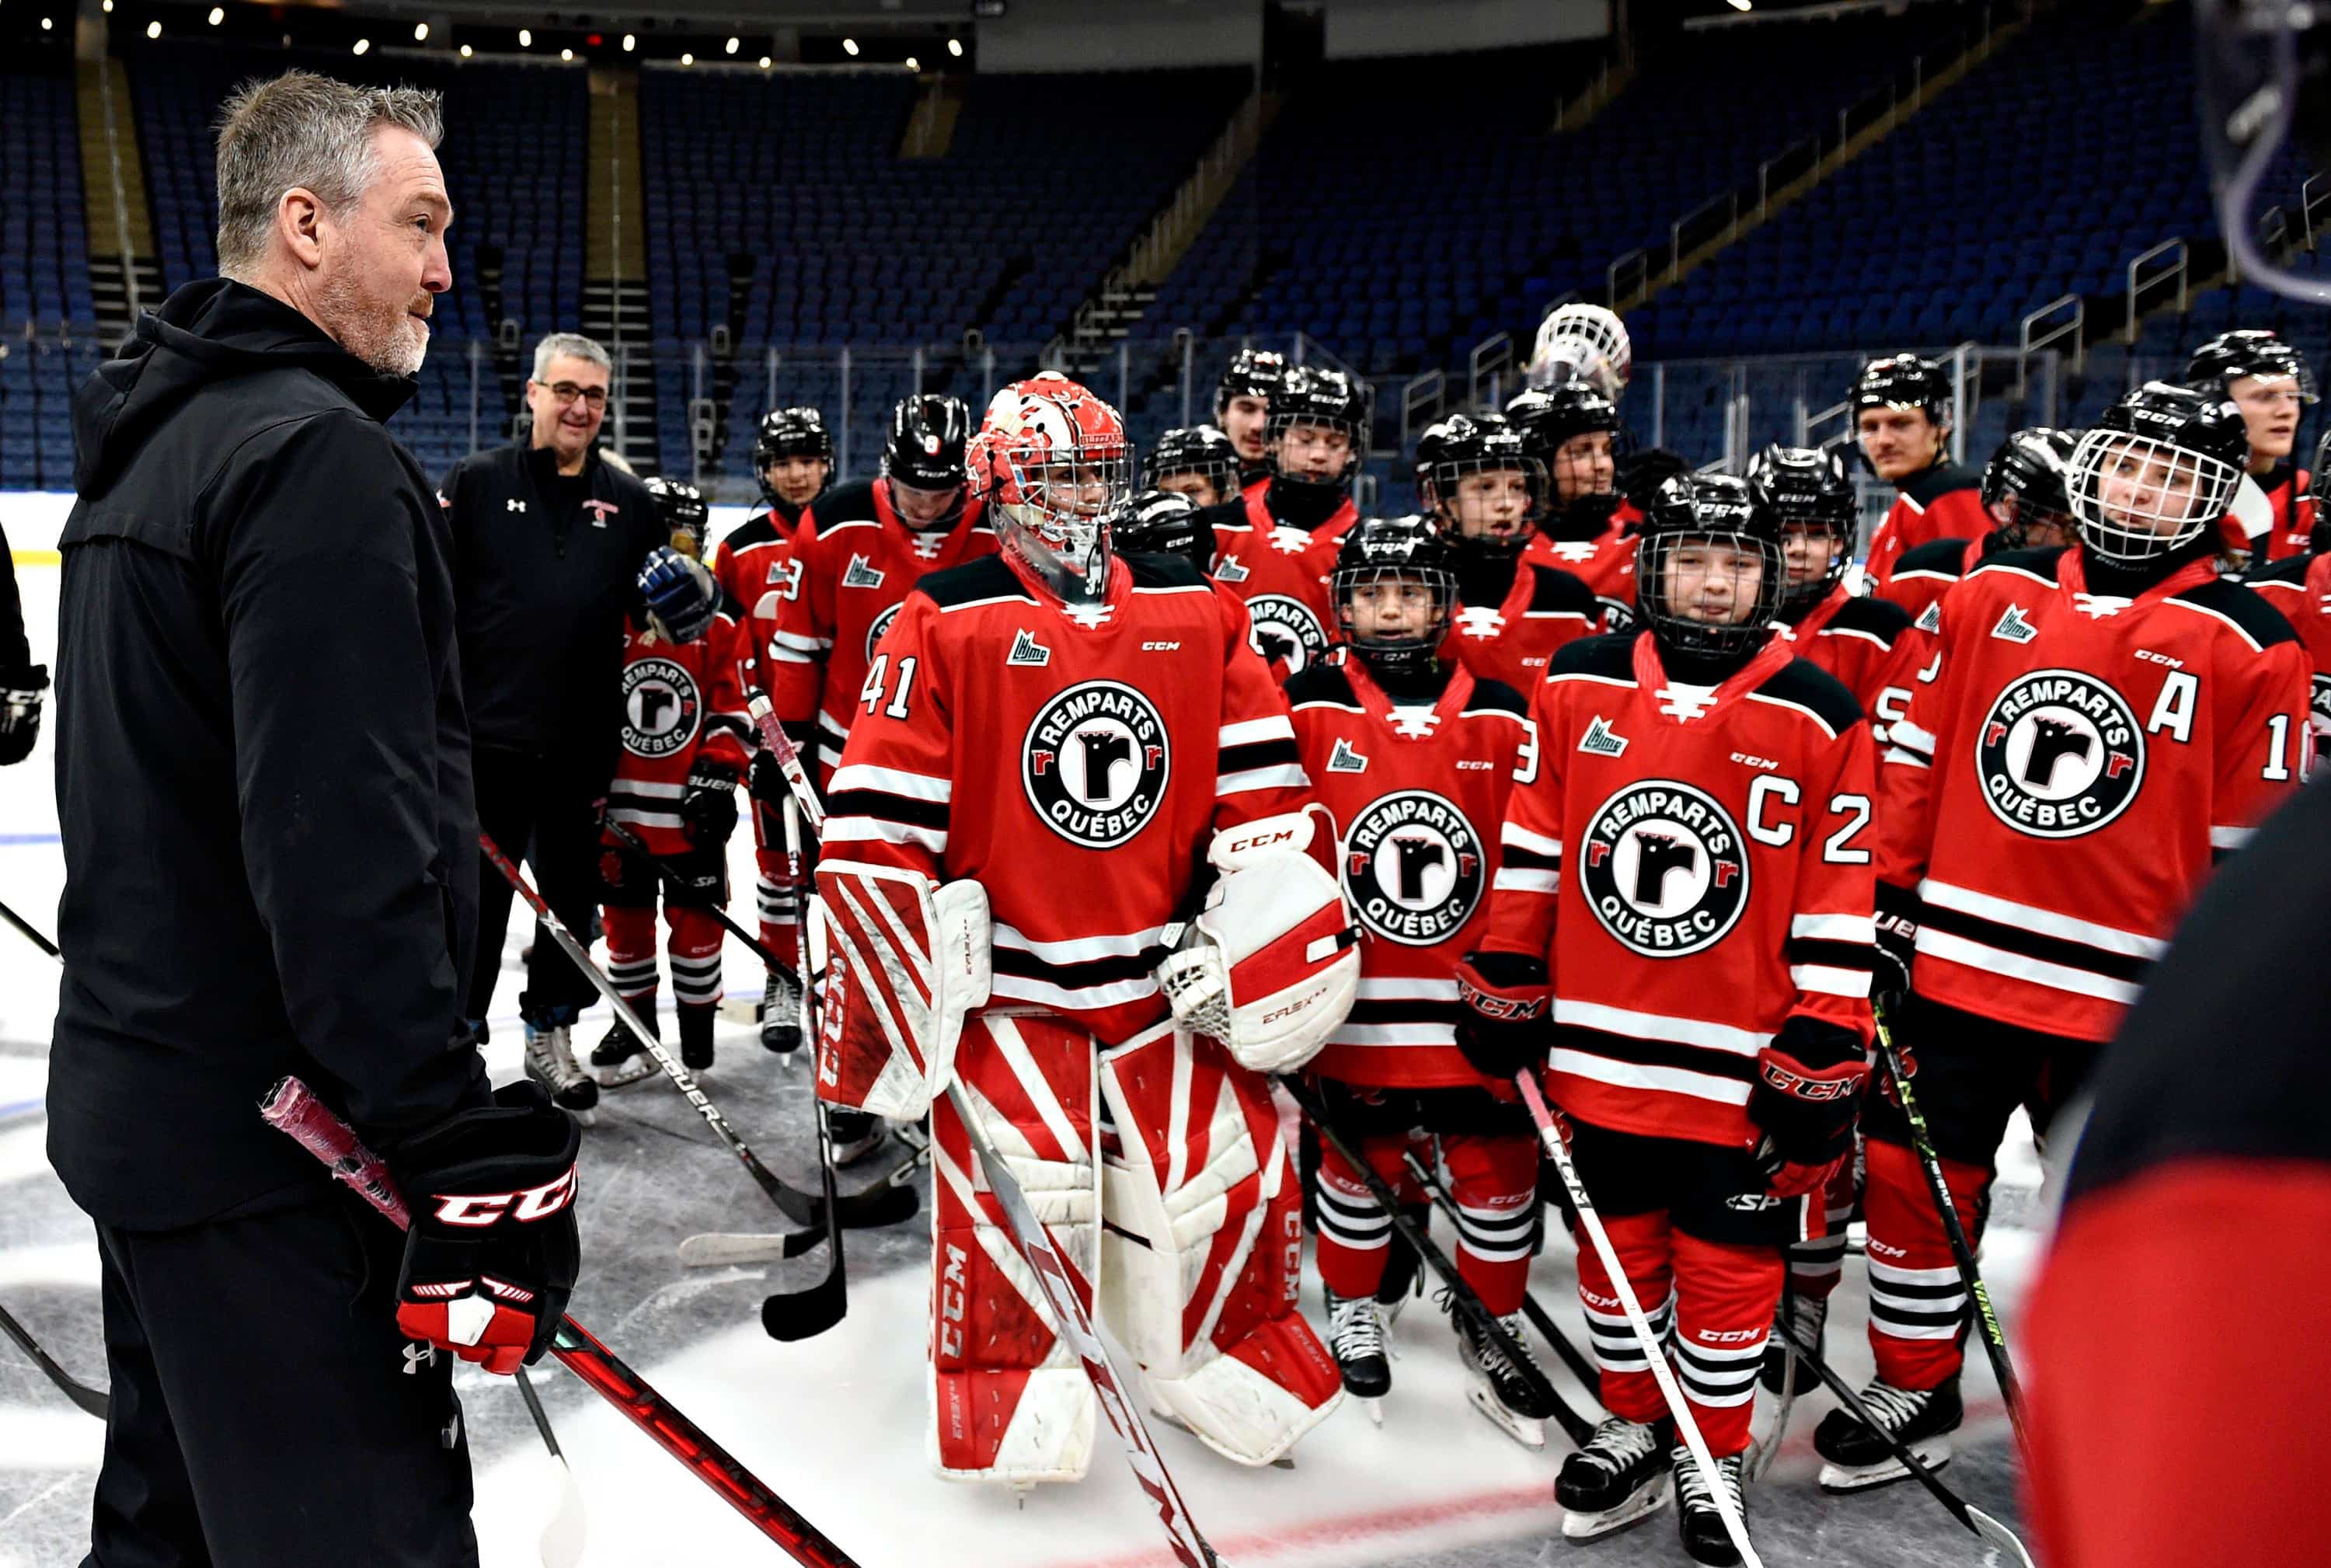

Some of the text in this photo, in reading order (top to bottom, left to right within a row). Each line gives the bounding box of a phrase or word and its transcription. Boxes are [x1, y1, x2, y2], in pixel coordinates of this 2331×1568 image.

[2134, 409, 2186, 427] CCM
[1141, 641, 1181, 651] CCM
[1249, 601, 1320, 646] MPARTS
[1521, 658, 1545, 667] CC
[2133, 650, 2184, 668] CCM
[860, 653, 916, 719] 41
[2147, 670, 2198, 742] A
[1038, 692, 1155, 747] REMPARTS
[2000, 678, 2131, 747] REMPARTS
[1455, 760, 1494, 771] CCM
[1730, 751, 1780, 770] CCM
[1050, 793, 1151, 838] QUÉBEC
[1599, 791, 1732, 855] REMPARTS
[1747, 774, 1800, 847] C
[1988, 772, 2103, 827] QUÉBEC
[1229, 829, 1294, 853] CCM
[1355, 800, 1469, 849] REMPARTS
[1366, 897, 1465, 937] QUÉBEC
[1600, 895, 1717, 947] QUÉBEC
[650, 1047, 721, 1124] BAUER
[1765, 1059, 1865, 1100] CCM
[431, 1163, 578, 1228] CC
[1284, 1209, 1301, 1301] CCM
[940, 1243, 968, 1360] CCM
[1698, 1327, 1761, 1343] CCM
